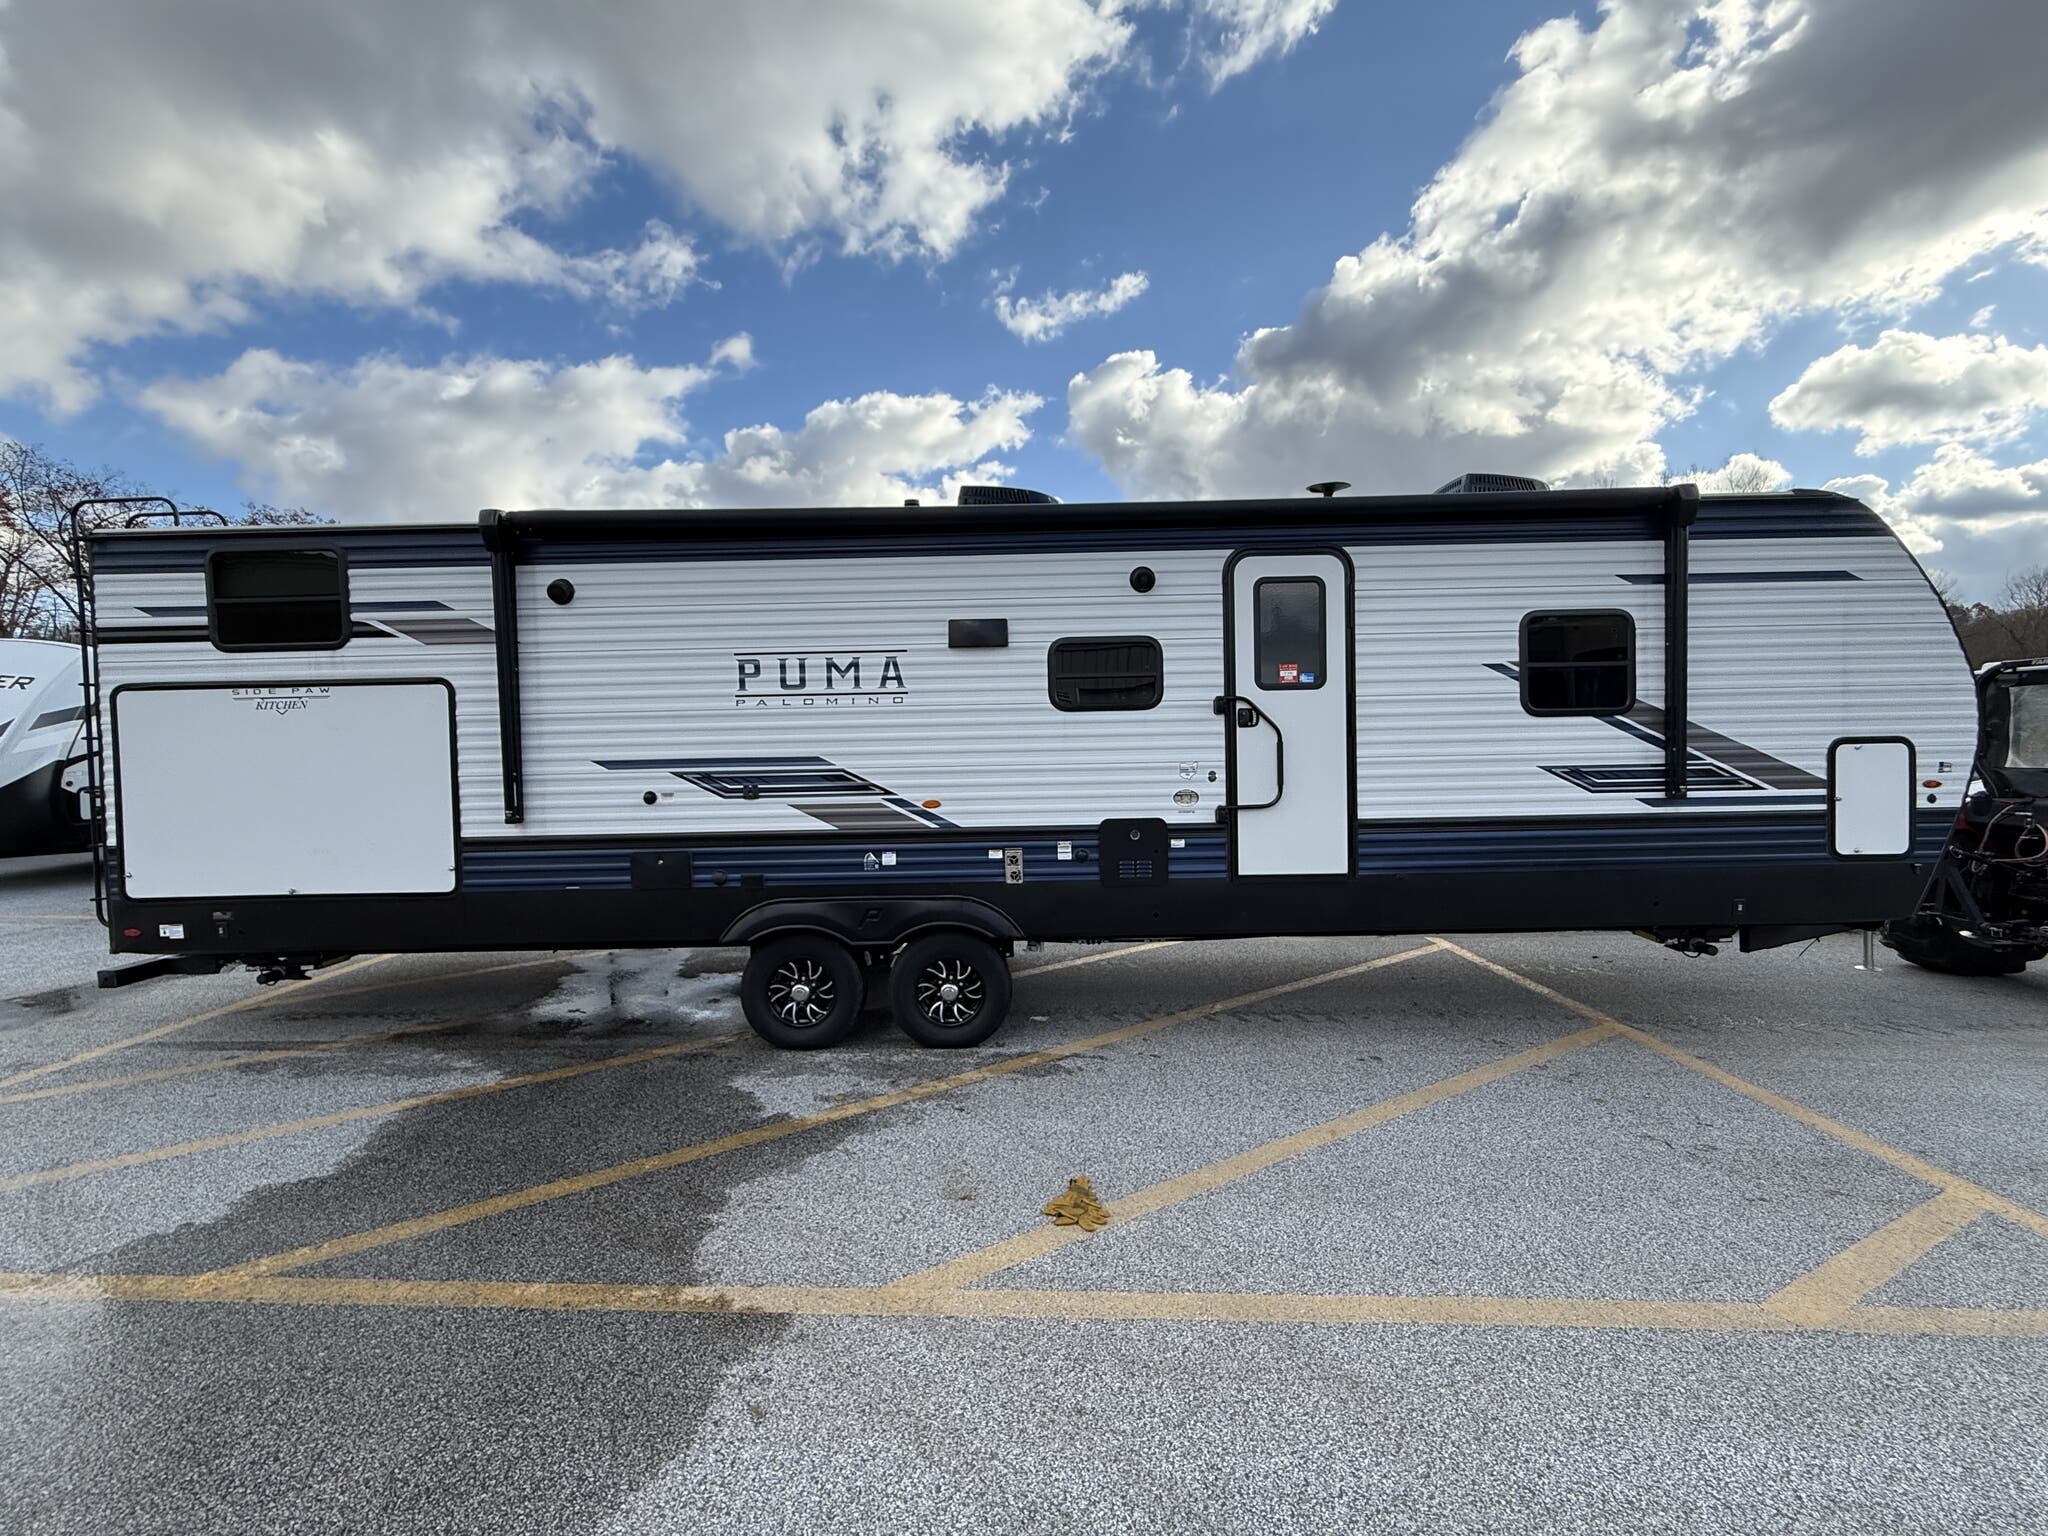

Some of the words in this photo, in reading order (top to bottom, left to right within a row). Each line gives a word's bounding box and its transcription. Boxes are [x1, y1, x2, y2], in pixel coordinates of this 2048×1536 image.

[736, 655, 907, 692] PUMA
[231, 687, 277, 696] SIDE
[291, 686, 330, 694] PAW
[255, 699, 309, 711] KITCHEN
[735, 696, 904, 707] PALOMINO
